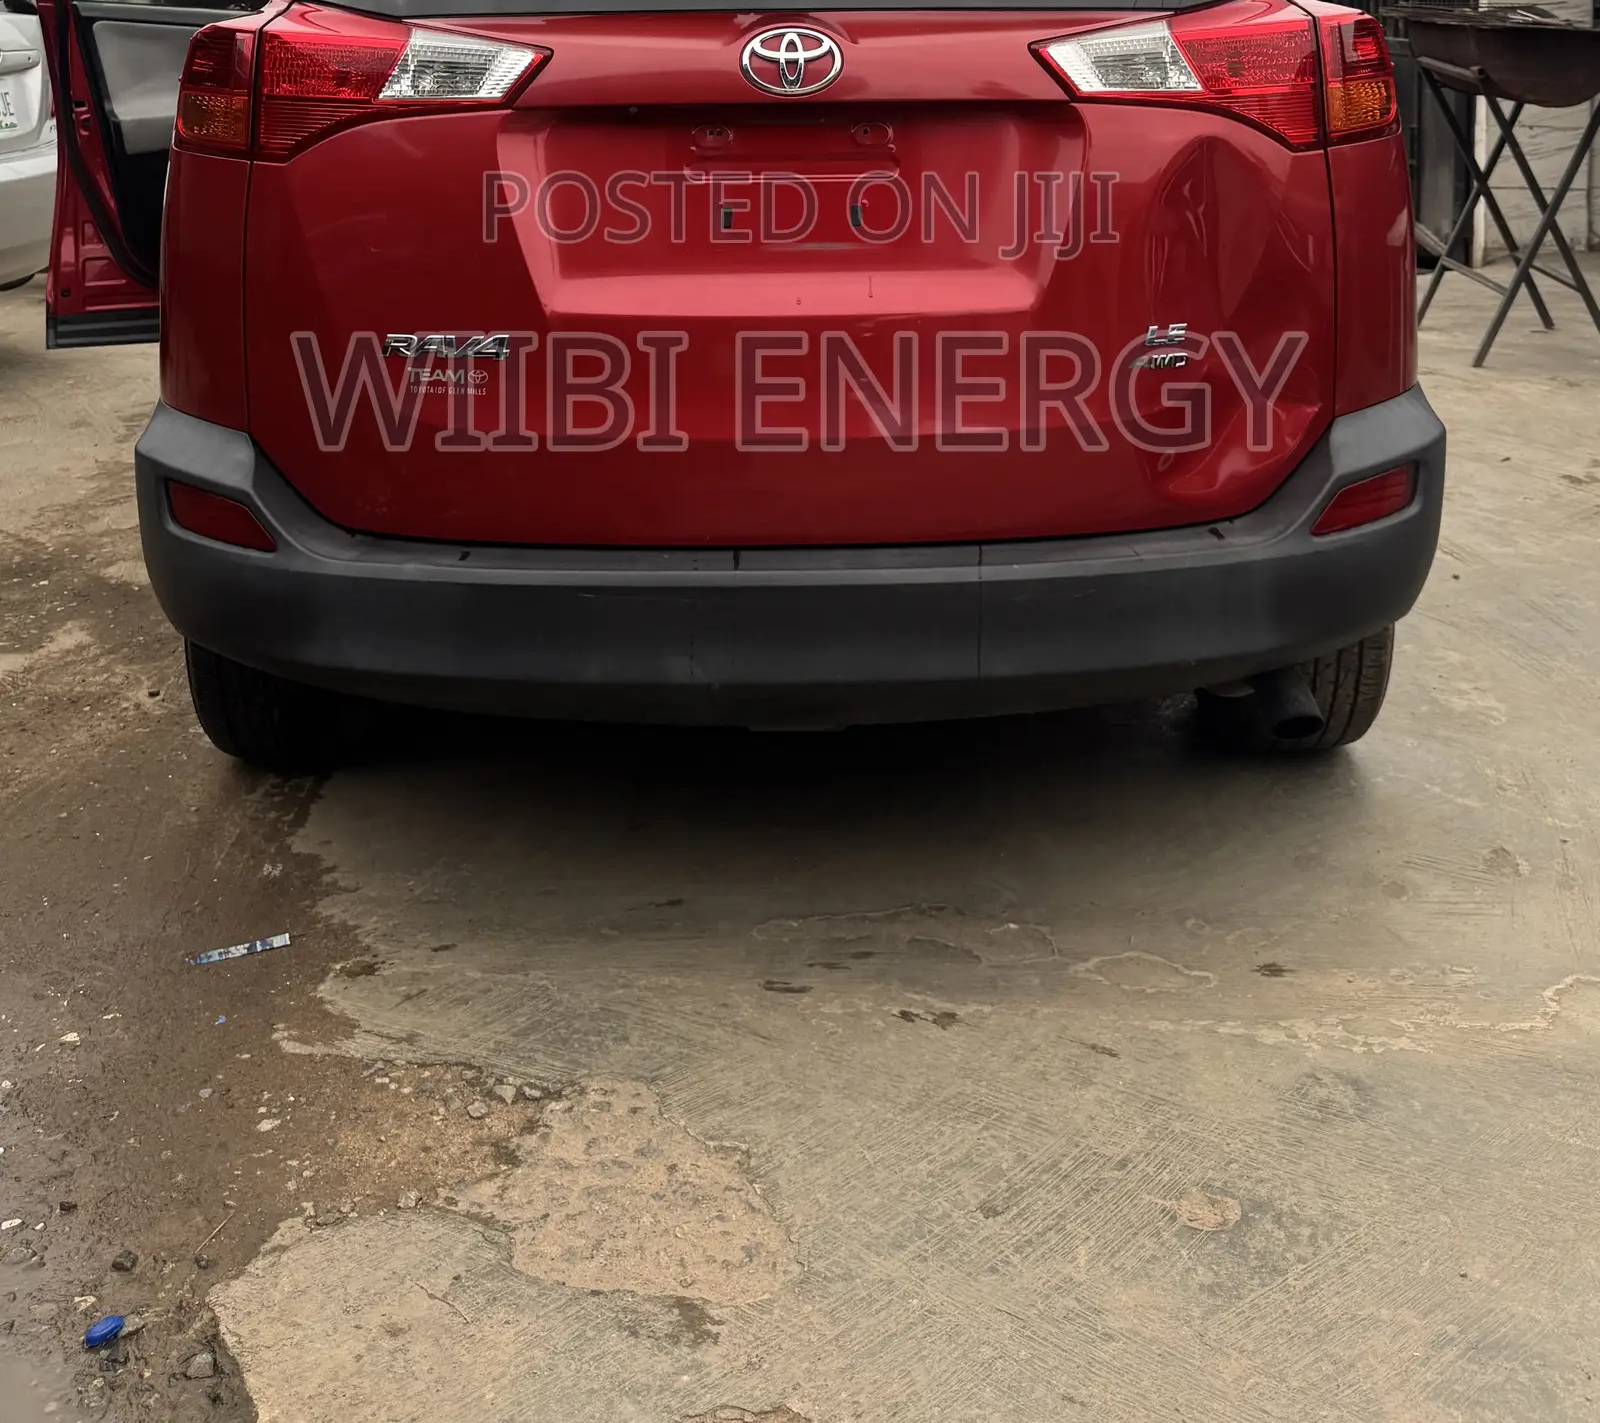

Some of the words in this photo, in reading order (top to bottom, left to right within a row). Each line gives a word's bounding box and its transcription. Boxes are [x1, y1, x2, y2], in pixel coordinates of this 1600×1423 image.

[1144, 323, 1188, 346] LE
[381, 334, 510, 360] RAV4
[407, 366, 465, 384] TEAM
[467, 387, 487, 396] MILLS
